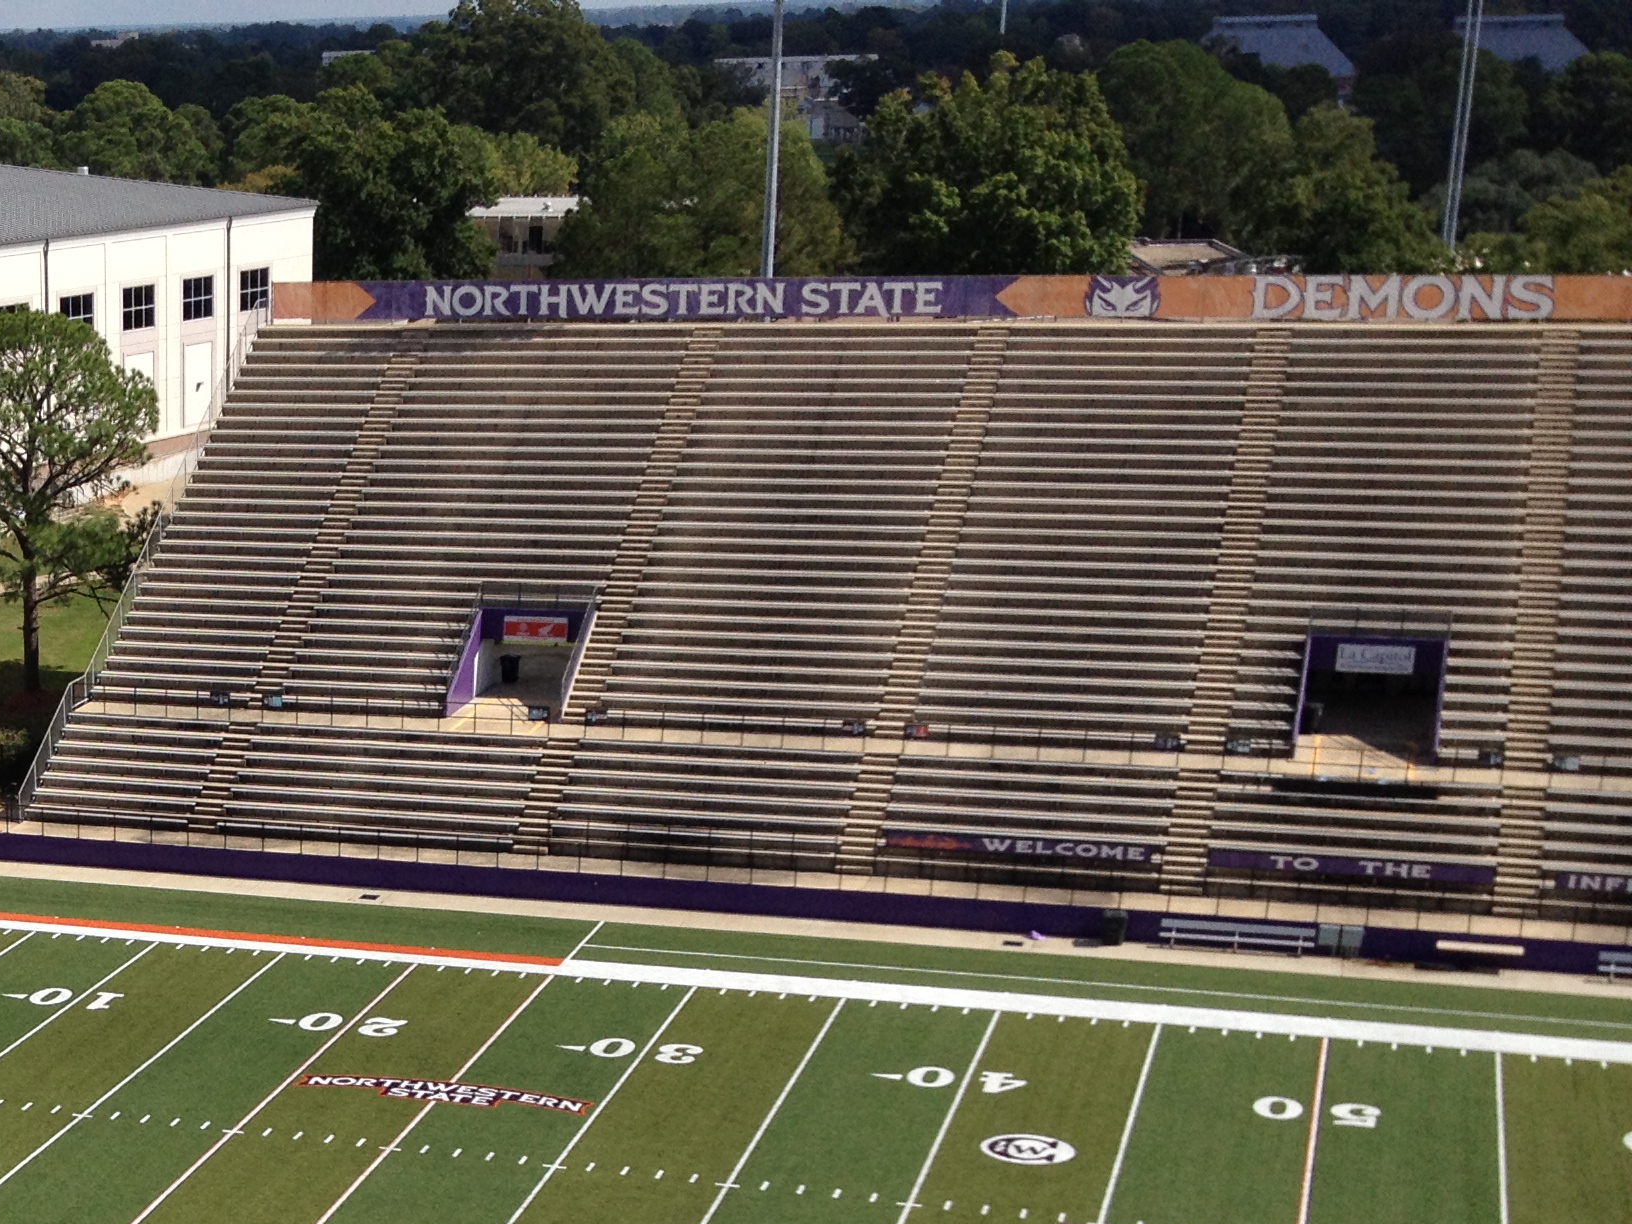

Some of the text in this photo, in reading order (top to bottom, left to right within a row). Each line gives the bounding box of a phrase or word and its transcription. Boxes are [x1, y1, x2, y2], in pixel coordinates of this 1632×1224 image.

[425, 281, 943, 318] NORTHWESTERN STATE
[1251, 274, 1554, 319] DEMONS
[981, 838, 1147, 860] WELCOME
[1270, 855, 1431, 879] TO THE
[308, 1076, 583, 1112] NORTHWESTERN
[387, 1087, 493, 1106] STATE
